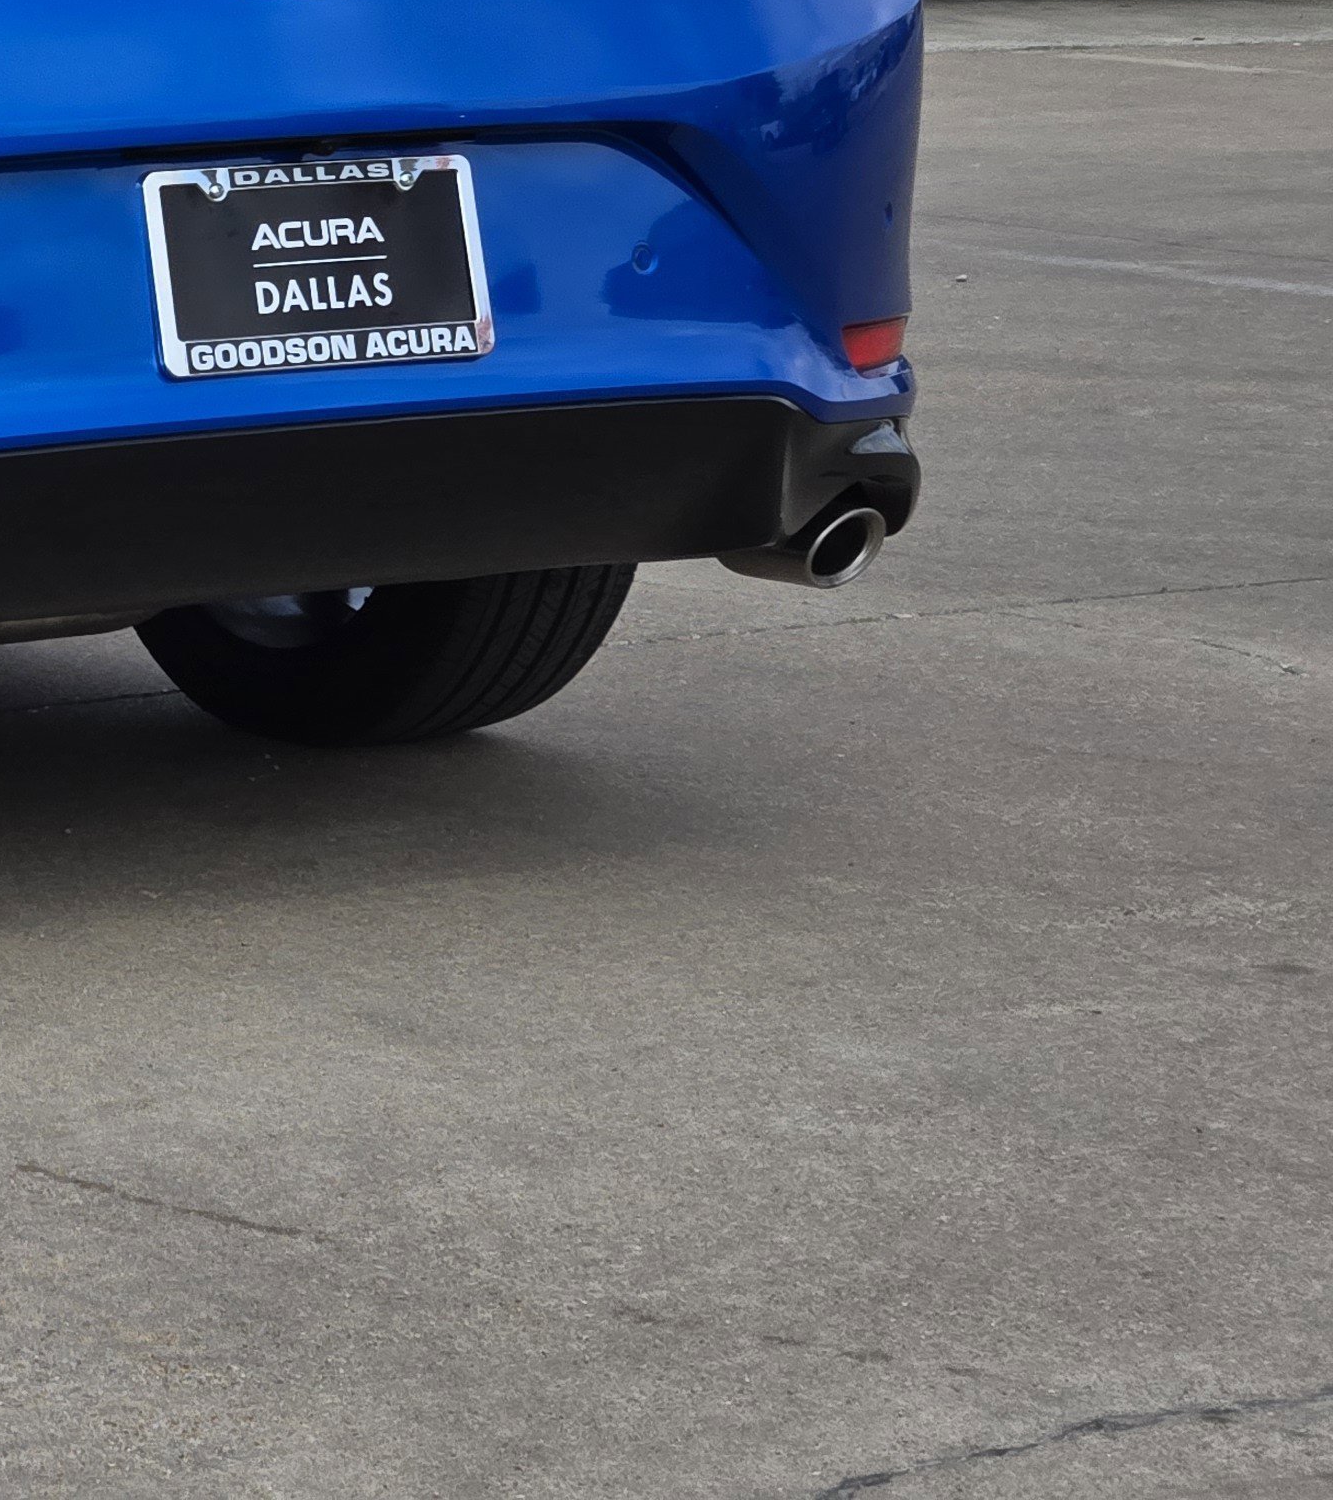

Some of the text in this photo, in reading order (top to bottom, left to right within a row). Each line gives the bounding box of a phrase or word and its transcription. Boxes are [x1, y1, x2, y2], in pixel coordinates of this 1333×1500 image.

[234, 162, 389, 186] DALLAS
[251, 216, 385, 251] ACURA
[254, 272, 393, 315] DALLAS
[190, 326, 476, 371] GOODSON ACURA
